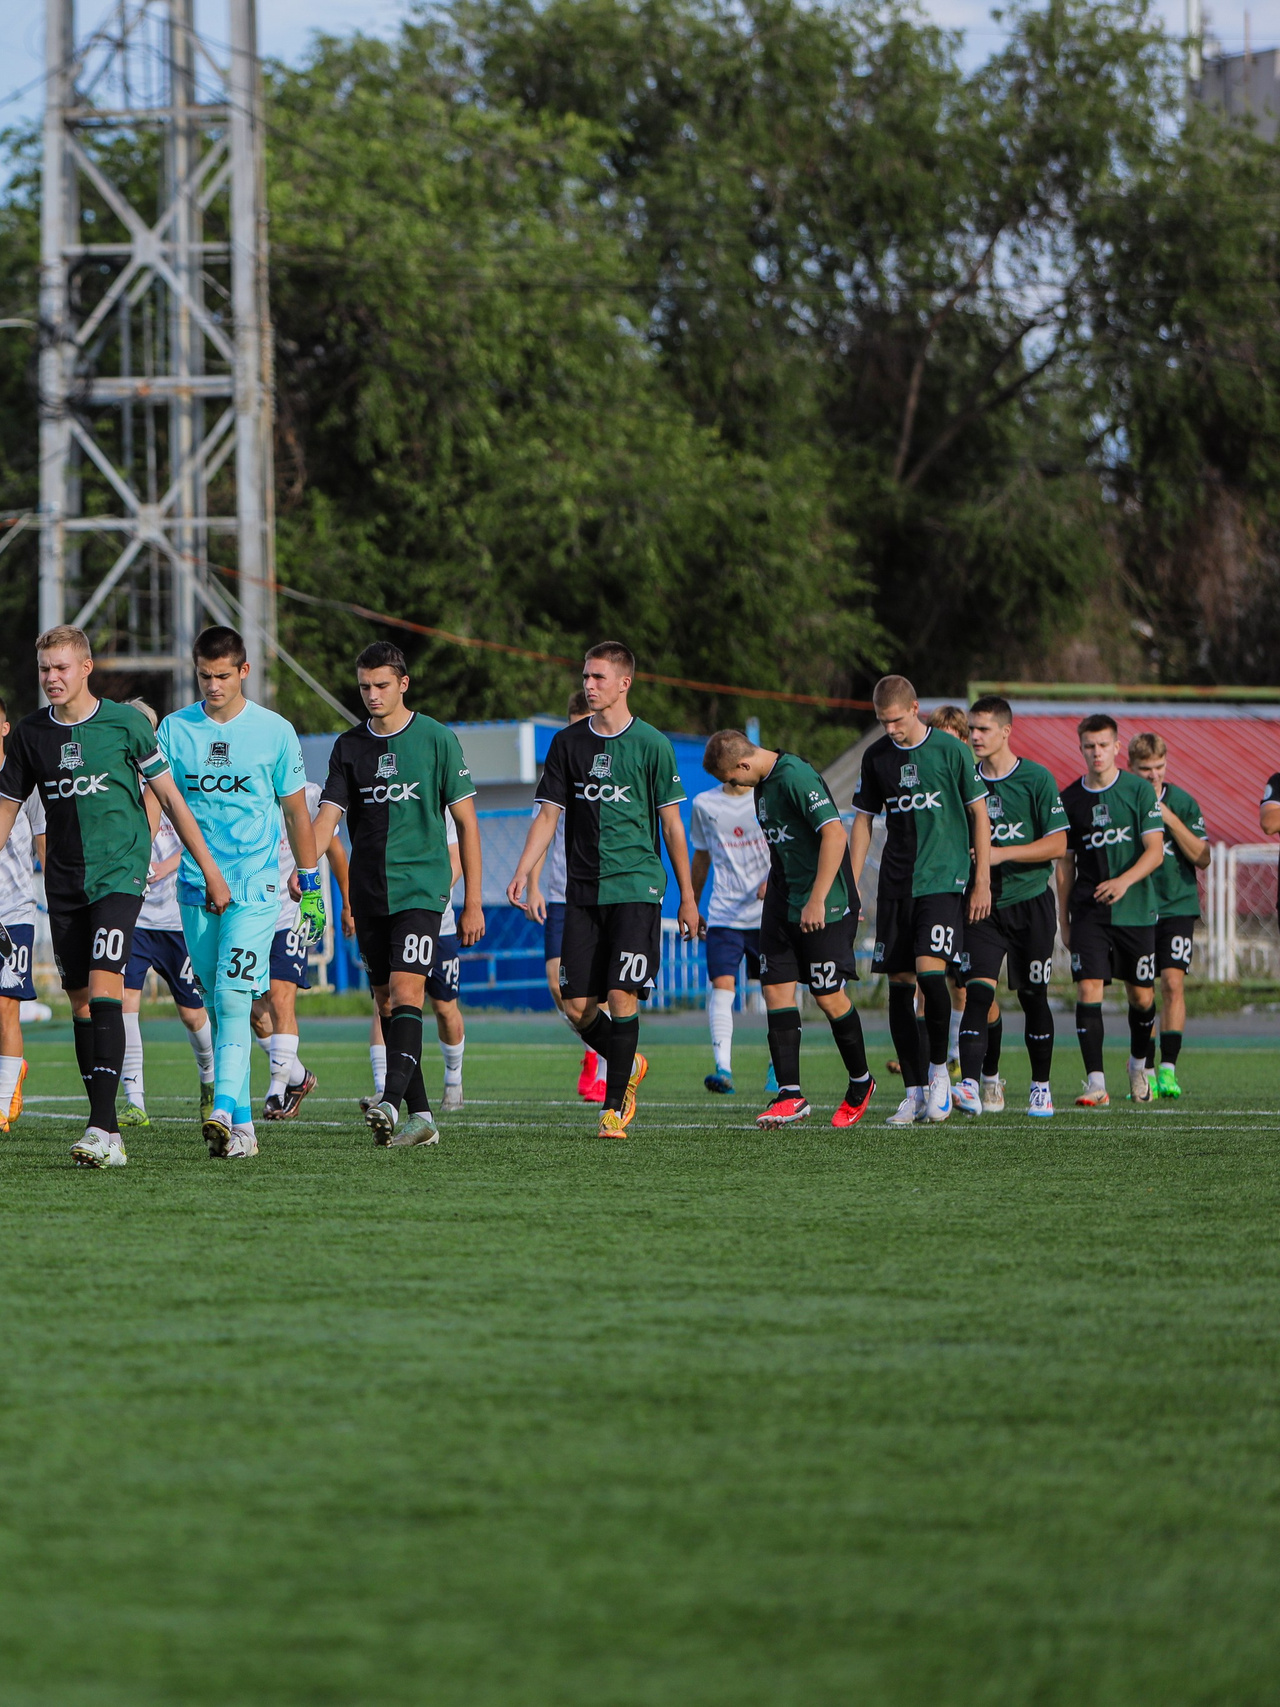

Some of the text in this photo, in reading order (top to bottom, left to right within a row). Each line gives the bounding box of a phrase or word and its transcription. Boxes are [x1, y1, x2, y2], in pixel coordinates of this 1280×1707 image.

[92, 927, 124, 961] 60
[403, 933, 433, 966] 80
[930, 924, 954, 955] 93
[1170, 935, 1192, 964] 92
[227, 947, 257, 982] 32
[442, 957, 459, 985] 79
[619, 951, 648, 982] 70
[810, 961, 838, 989] 52
[1029, 957, 1052, 985] 86
[1136, 952, 1155, 981] 63
